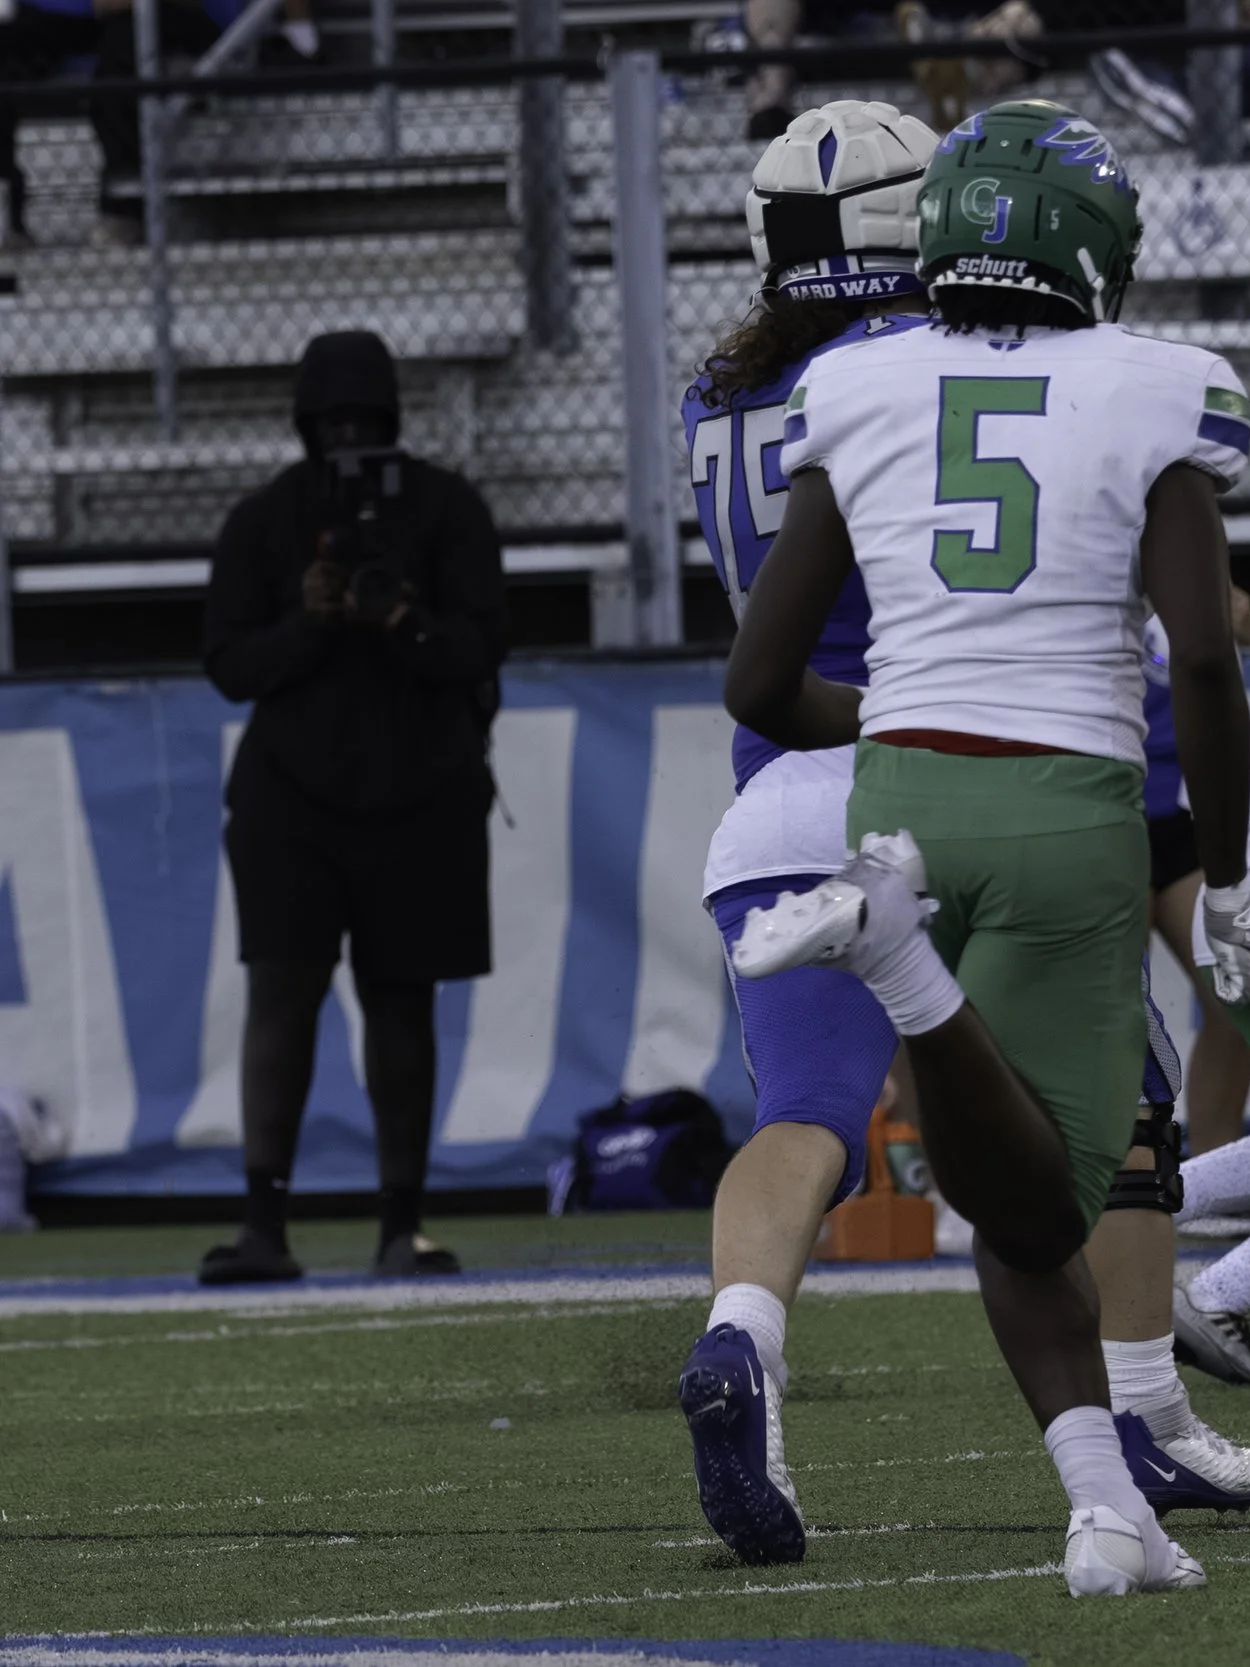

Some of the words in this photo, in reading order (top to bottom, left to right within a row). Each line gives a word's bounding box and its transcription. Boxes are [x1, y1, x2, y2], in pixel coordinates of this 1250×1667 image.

[1049, 208, 1060, 231] 5
[956, 254, 1028, 277] schutt
[788, 284, 837, 300] HARD
[840, 275, 900, 297] WAY
[930, 375, 1051, 594] 5
